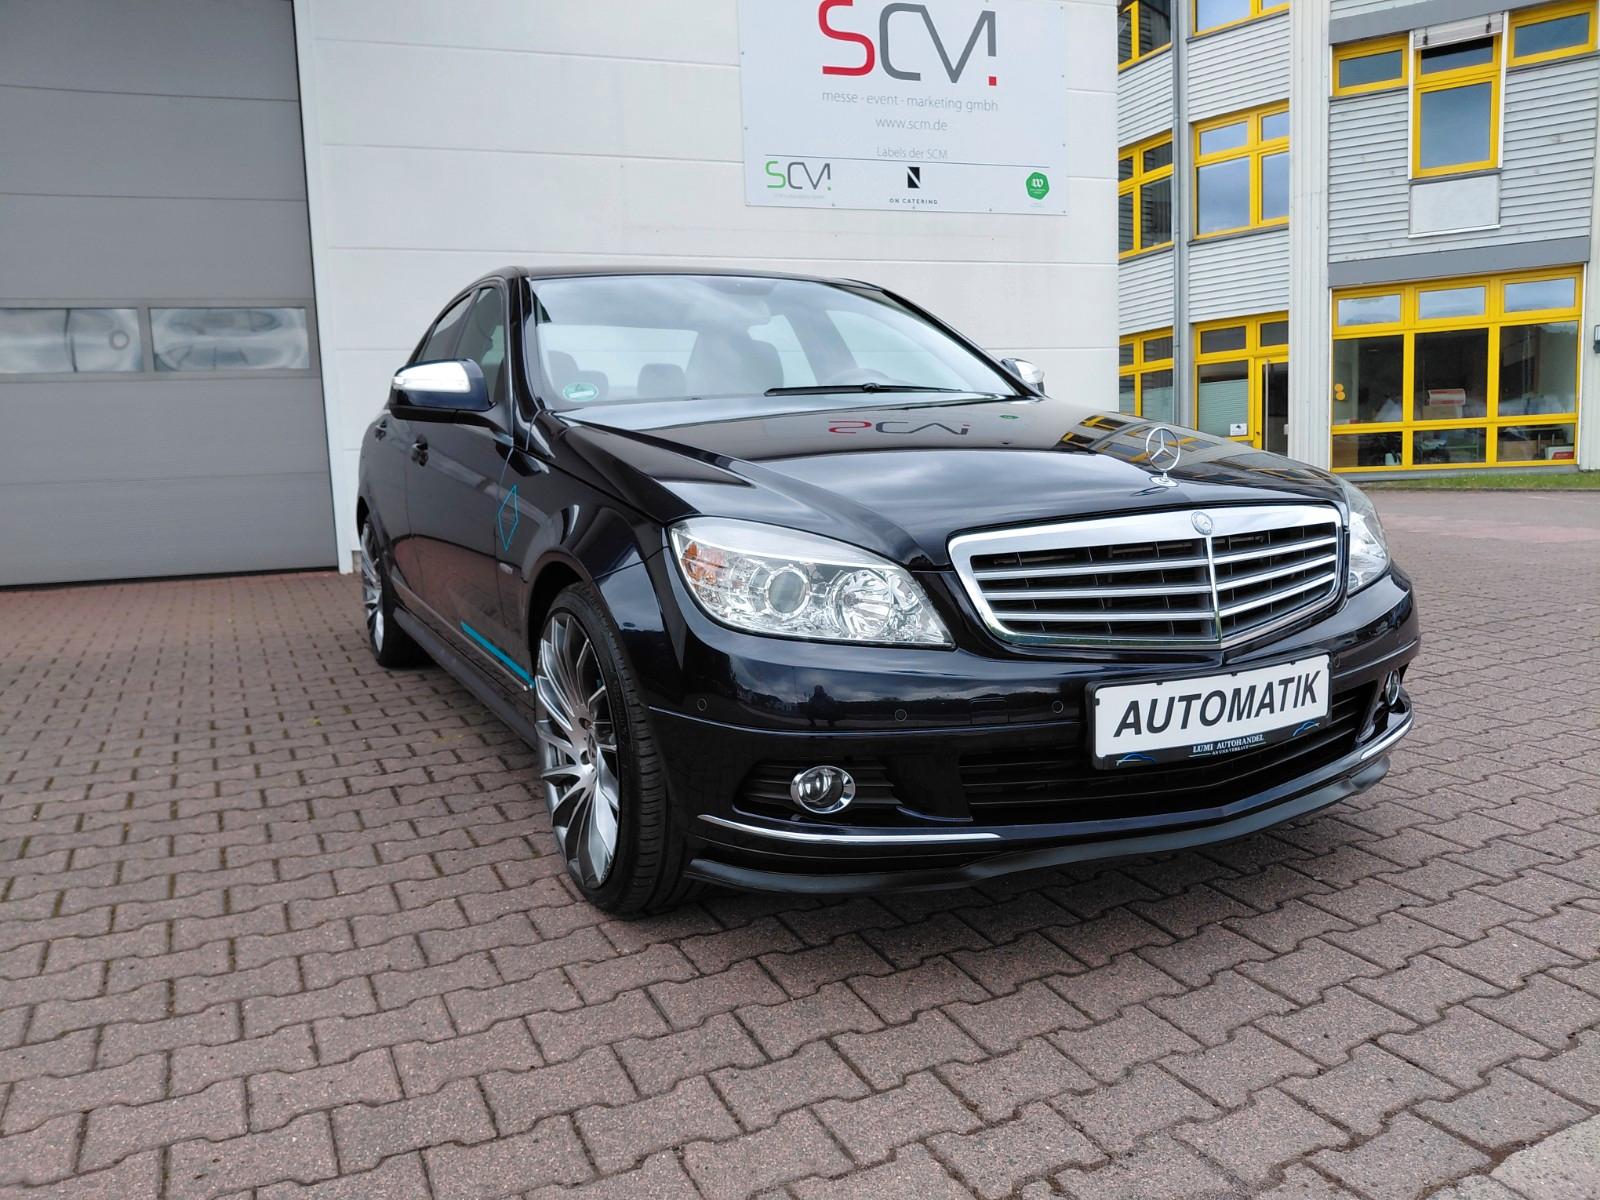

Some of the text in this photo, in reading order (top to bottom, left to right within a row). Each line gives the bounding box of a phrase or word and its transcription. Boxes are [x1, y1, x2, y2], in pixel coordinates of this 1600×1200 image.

[822, 91, 998, 113] messe event marketing gmbh
[875, 117, 948, 131] www.scm.de
[876, 146, 948, 160] Labels der SCM
[1113, 670, 1321, 738] AUTOMATIK
[1192, 734, 1265, 753] LUMI AUTOHANDEL
